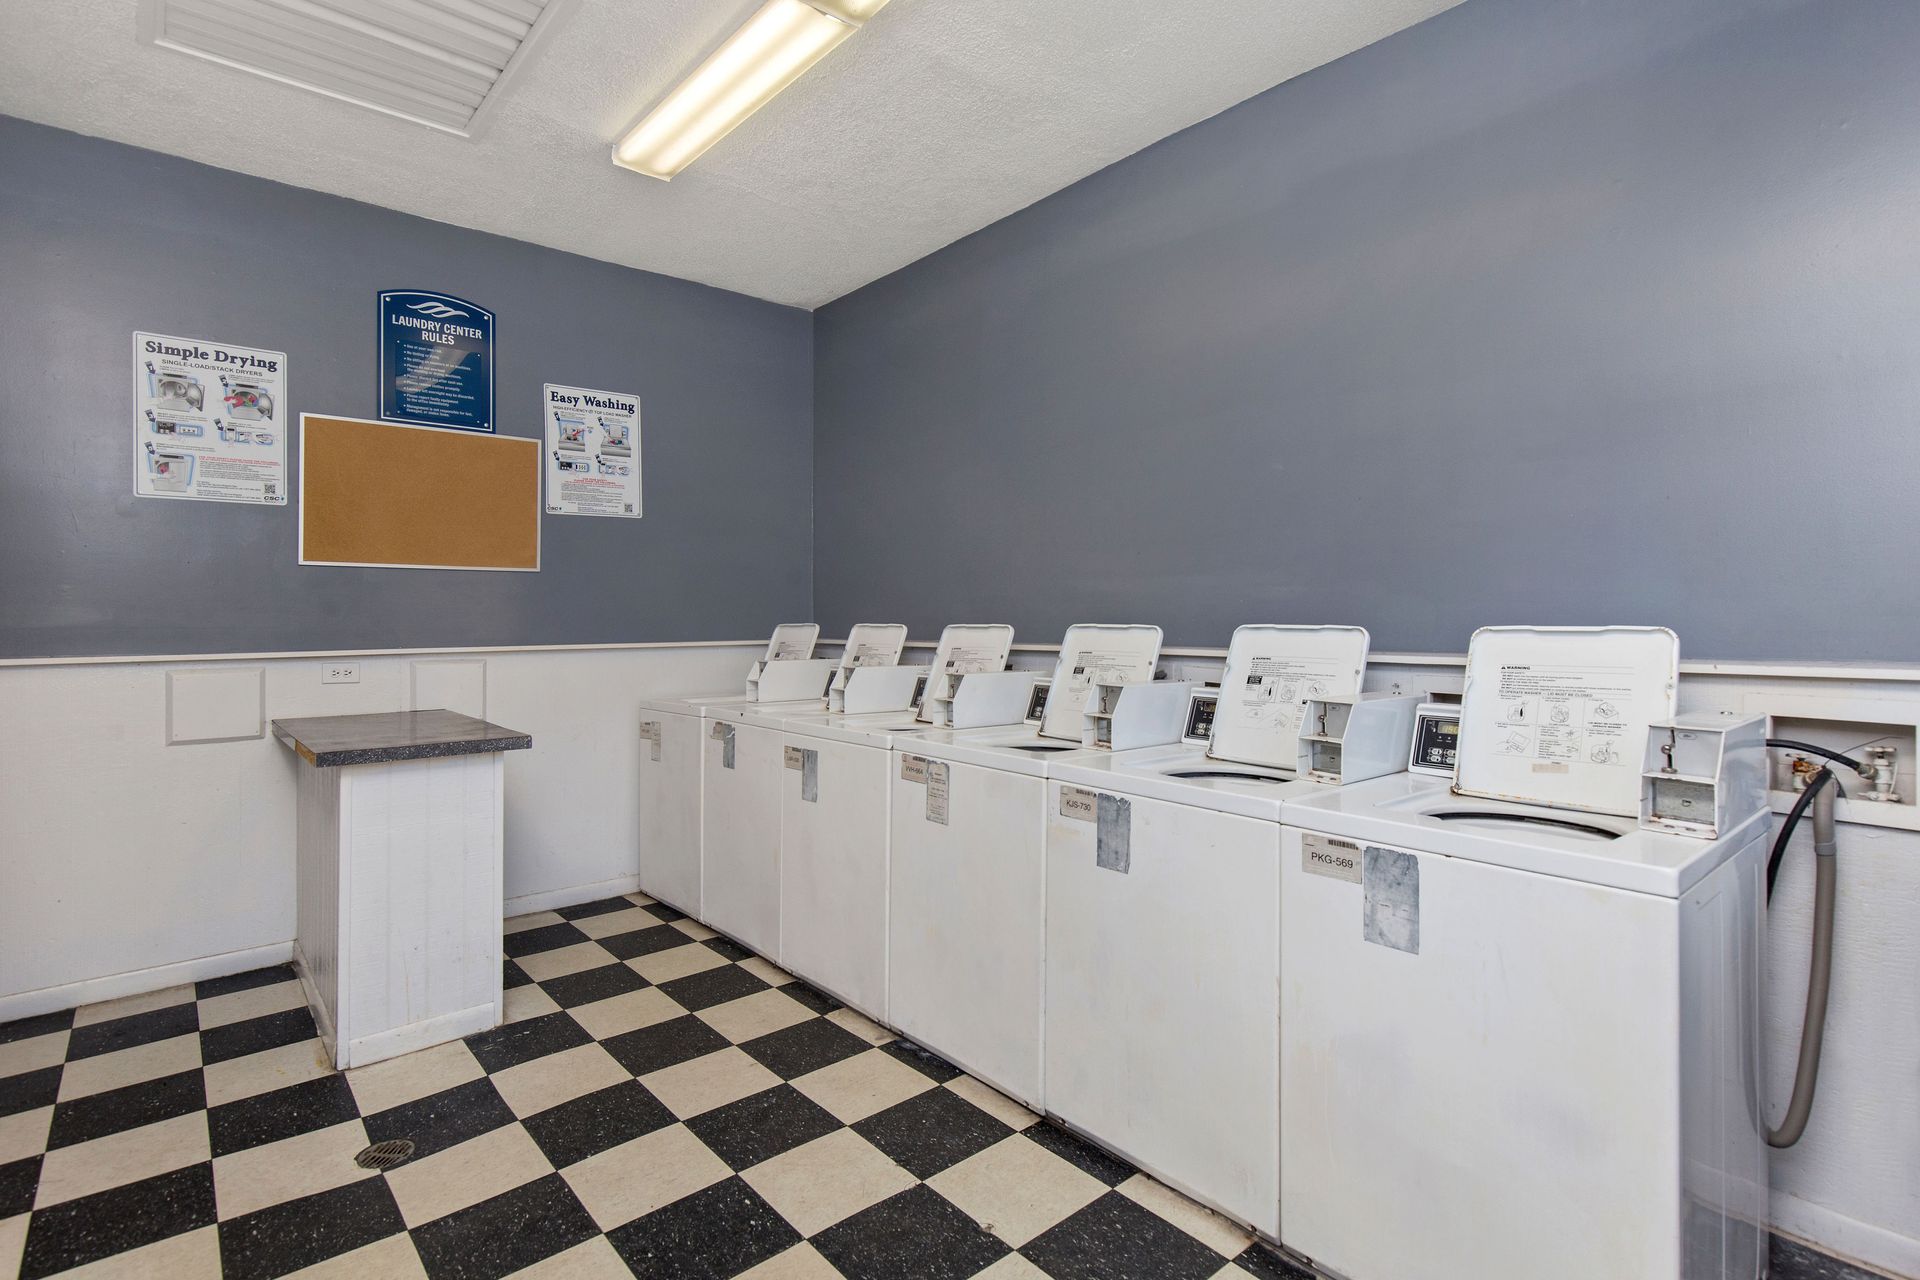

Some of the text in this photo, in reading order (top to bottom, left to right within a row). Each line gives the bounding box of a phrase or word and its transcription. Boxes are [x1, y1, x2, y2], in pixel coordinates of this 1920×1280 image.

[392, 314, 482, 339] LAUNDRY CENTER
[422, 331, 455, 345] RULES
[145, 340, 278, 372] Simple Drying
[235, 368, 263, 377] DRYERS
[551, 391, 635, 414] Easy Washing
[1066, 799, 1091, 811] KJS-730
[1311, 852, 1354, 868] PKG-569
